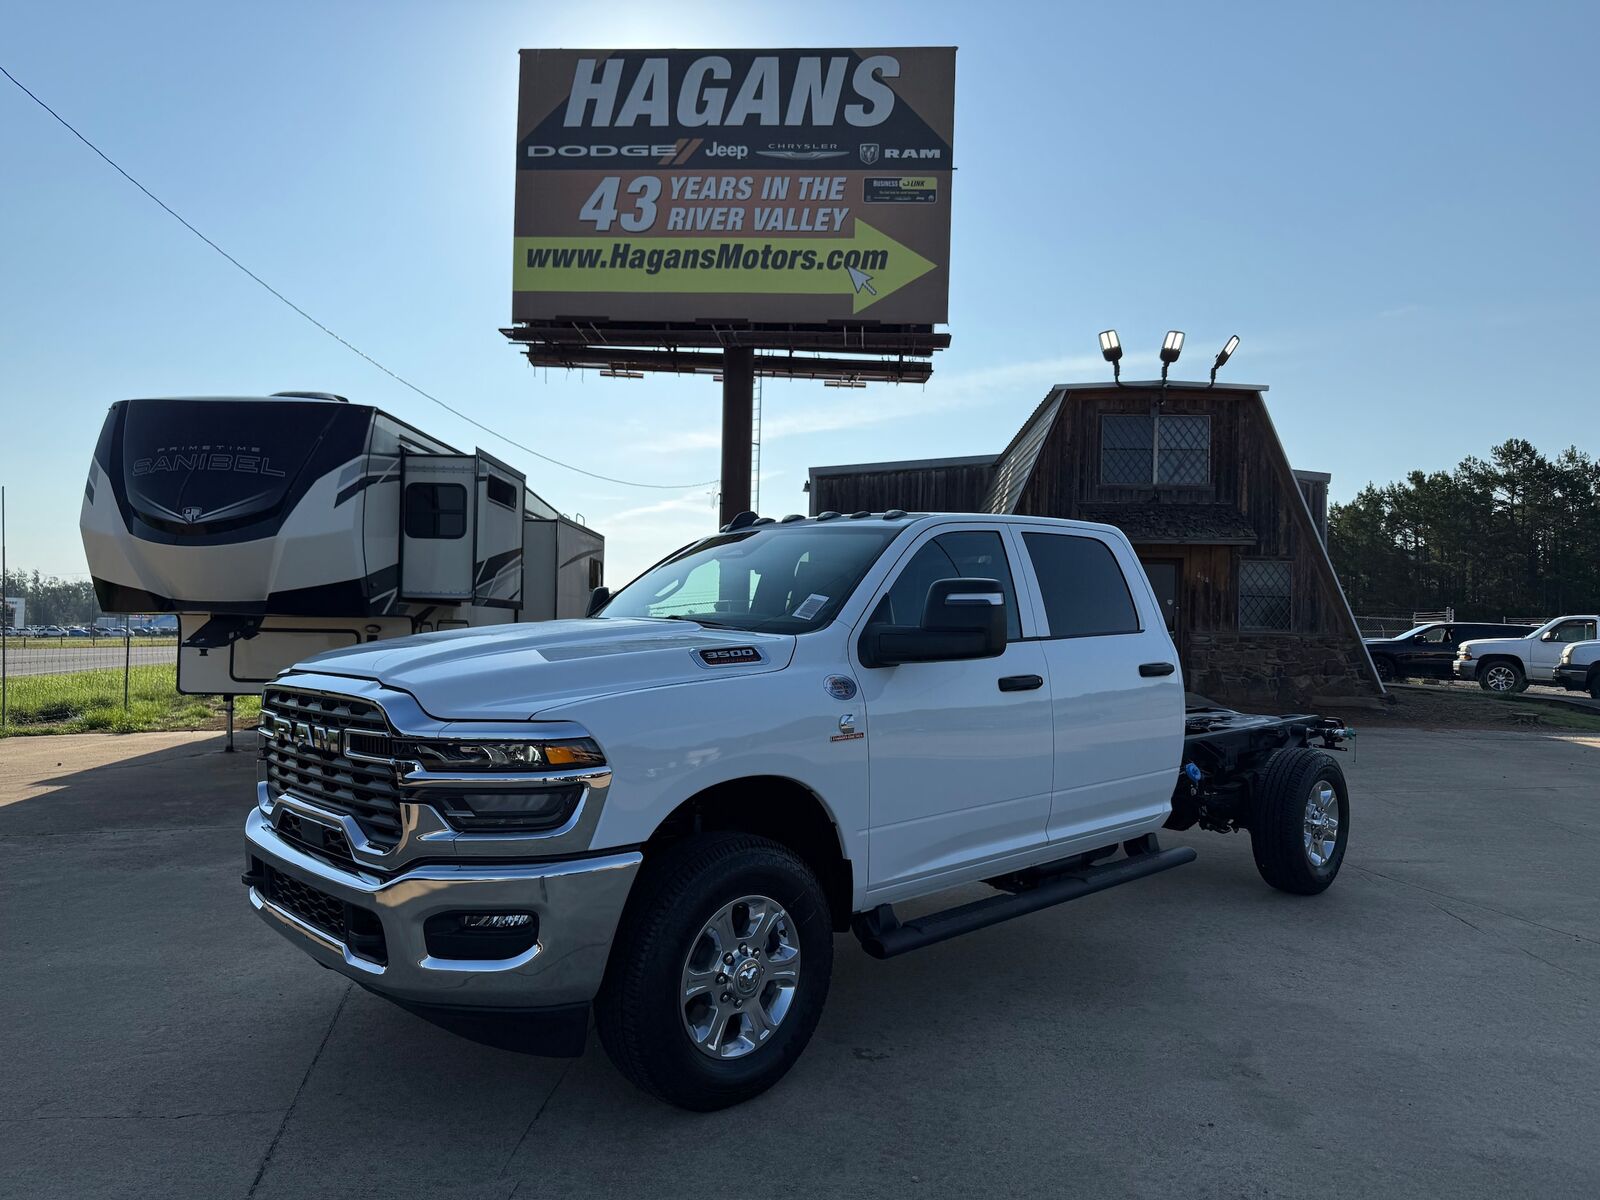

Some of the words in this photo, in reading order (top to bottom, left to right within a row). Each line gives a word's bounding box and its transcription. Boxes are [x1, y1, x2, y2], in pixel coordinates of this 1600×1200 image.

[562, 55, 901, 128] HAGANS
[527, 145, 677, 157] DODGE
[705, 141, 748, 160] Jeep
[884, 149, 941, 159] RAM
[670, 175, 754, 201] YEARS
[761, 175, 791, 201] IN
[798, 175, 847, 201] THE
[910, 180, 926, 188] LINK
[578, 175, 663, 233] 43
[666, 206, 744, 232] RIVER
[752, 206, 850, 232] VALLEY
[526, 243, 889, 275] www.HagansMotors.com
[132, 453, 286, 477] SANIBEL
[705, 649, 754, 659] 3500
[274, 718, 340, 754] RAM
